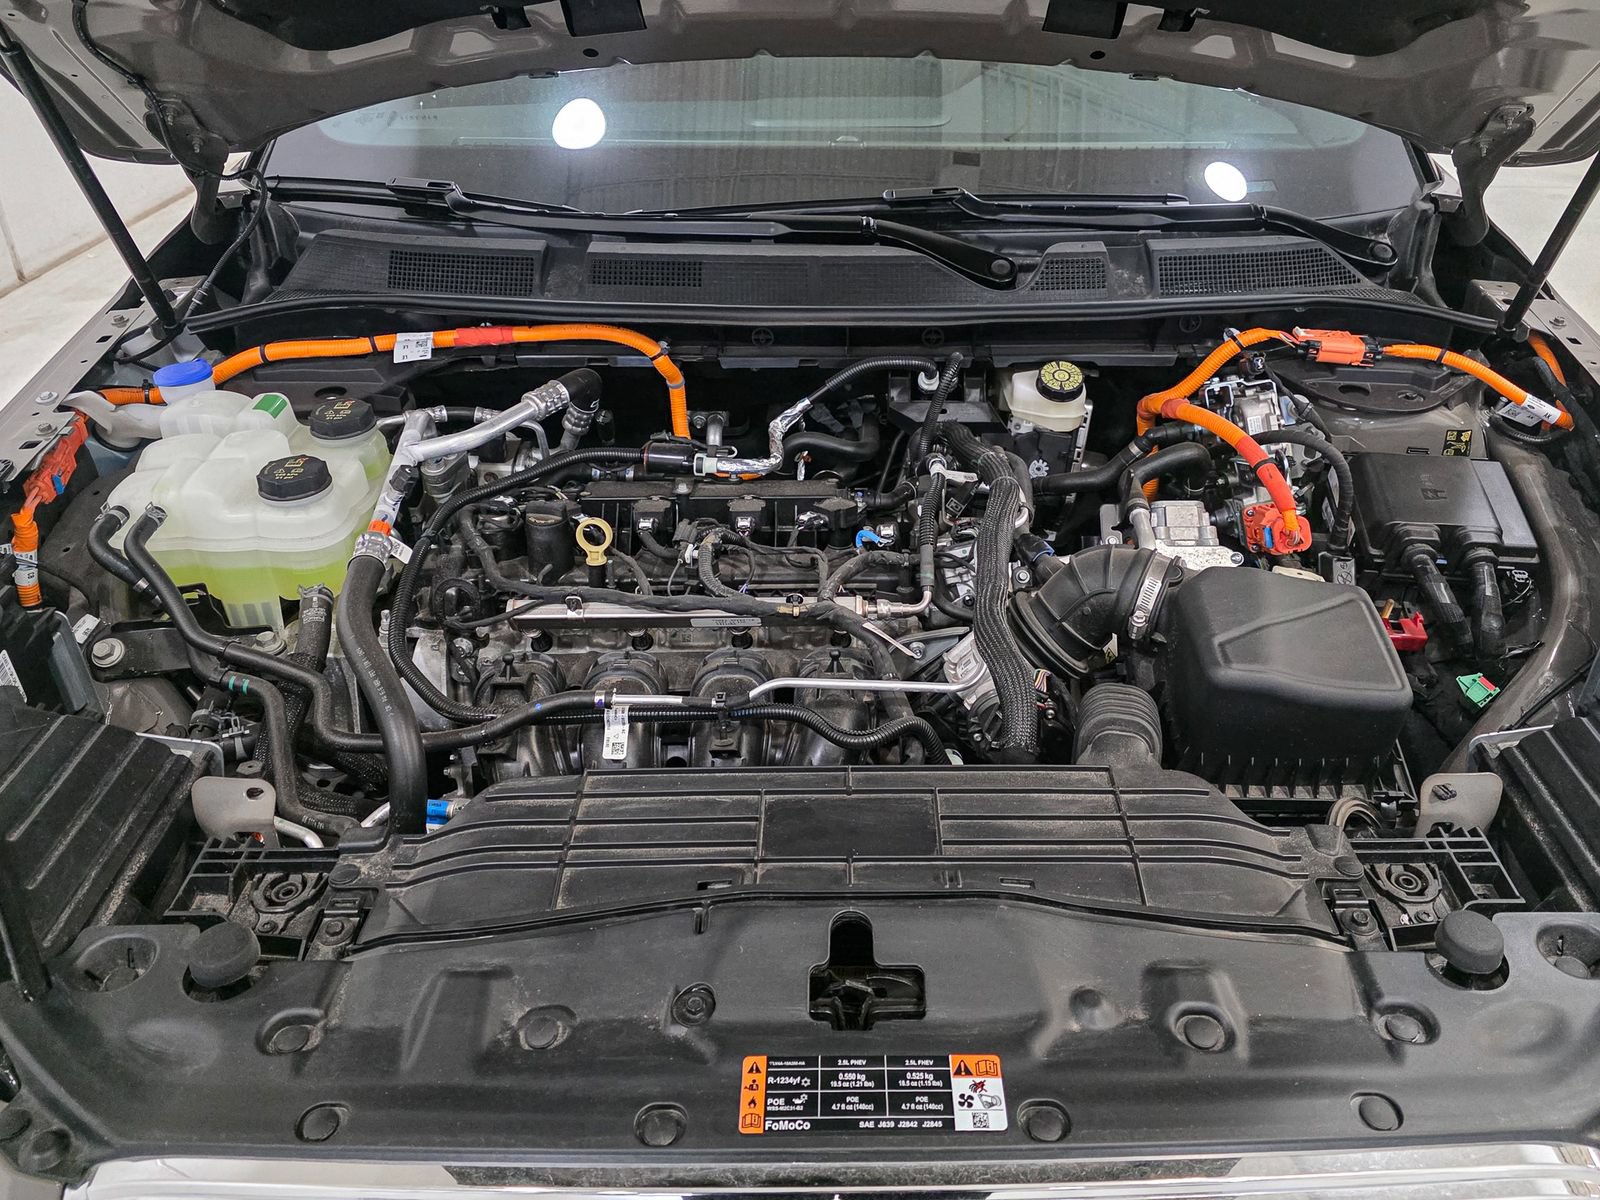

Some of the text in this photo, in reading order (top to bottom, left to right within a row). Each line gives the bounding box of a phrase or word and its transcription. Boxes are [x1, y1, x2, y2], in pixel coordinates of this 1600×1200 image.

[768, 1076, 801, 1086] R-1234yf
[857, 1072, 866, 1081] kg
[925, 1072, 934, 1081] kg
[853, 1103, 874, 1111] (140cc)
[923, 1103, 944, 1111] (140cc)
[765, 1120, 811, 1131] FoMoCo
[859, 1120, 875, 1128] SAE
[878, 1120, 895, 1128] J639
